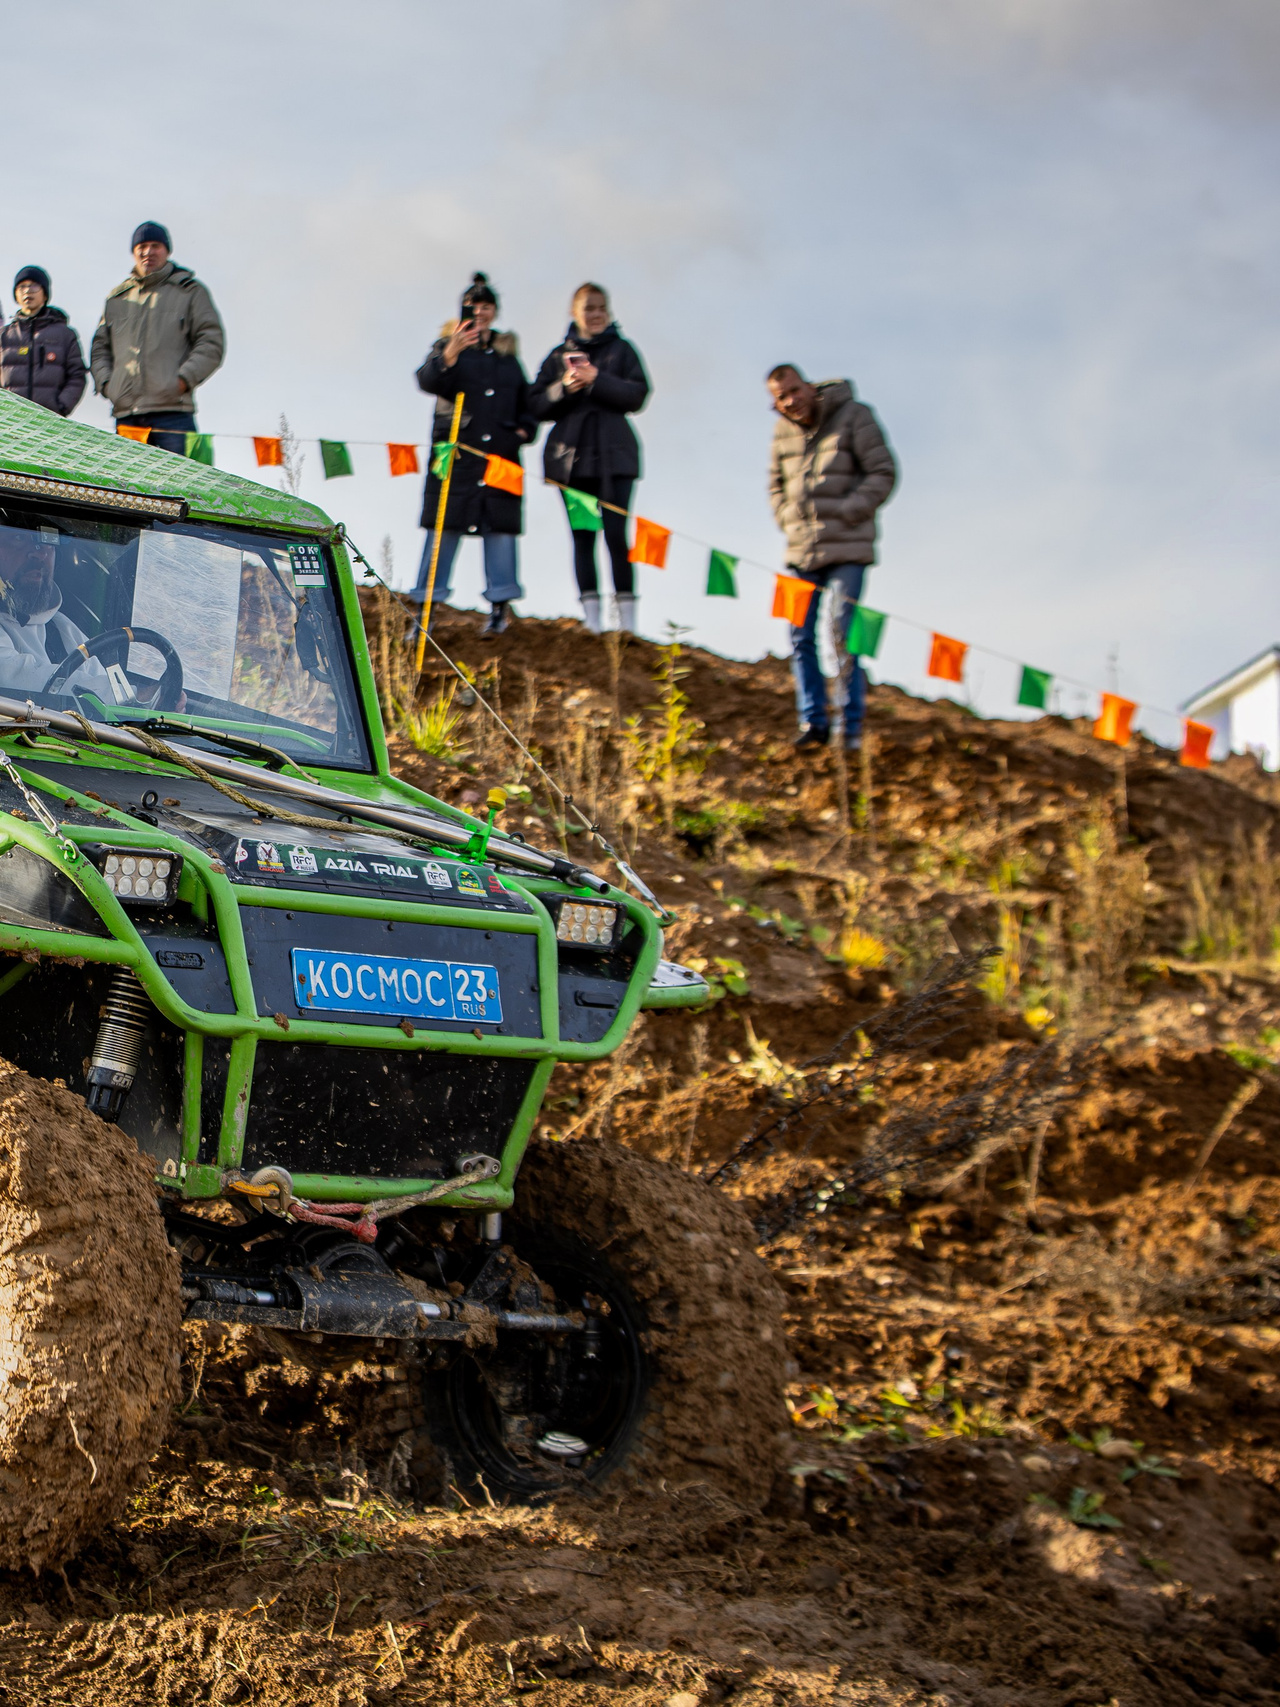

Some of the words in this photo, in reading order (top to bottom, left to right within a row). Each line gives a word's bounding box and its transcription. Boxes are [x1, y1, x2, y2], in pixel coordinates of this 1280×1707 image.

[324, 857, 369, 873] AZIA
[370, 861, 419, 879] TRIAL
[308, 959, 447, 1007] КОСМОС
[454, 969, 488, 1003] 23
[462, 1002, 487, 1016] RUS
